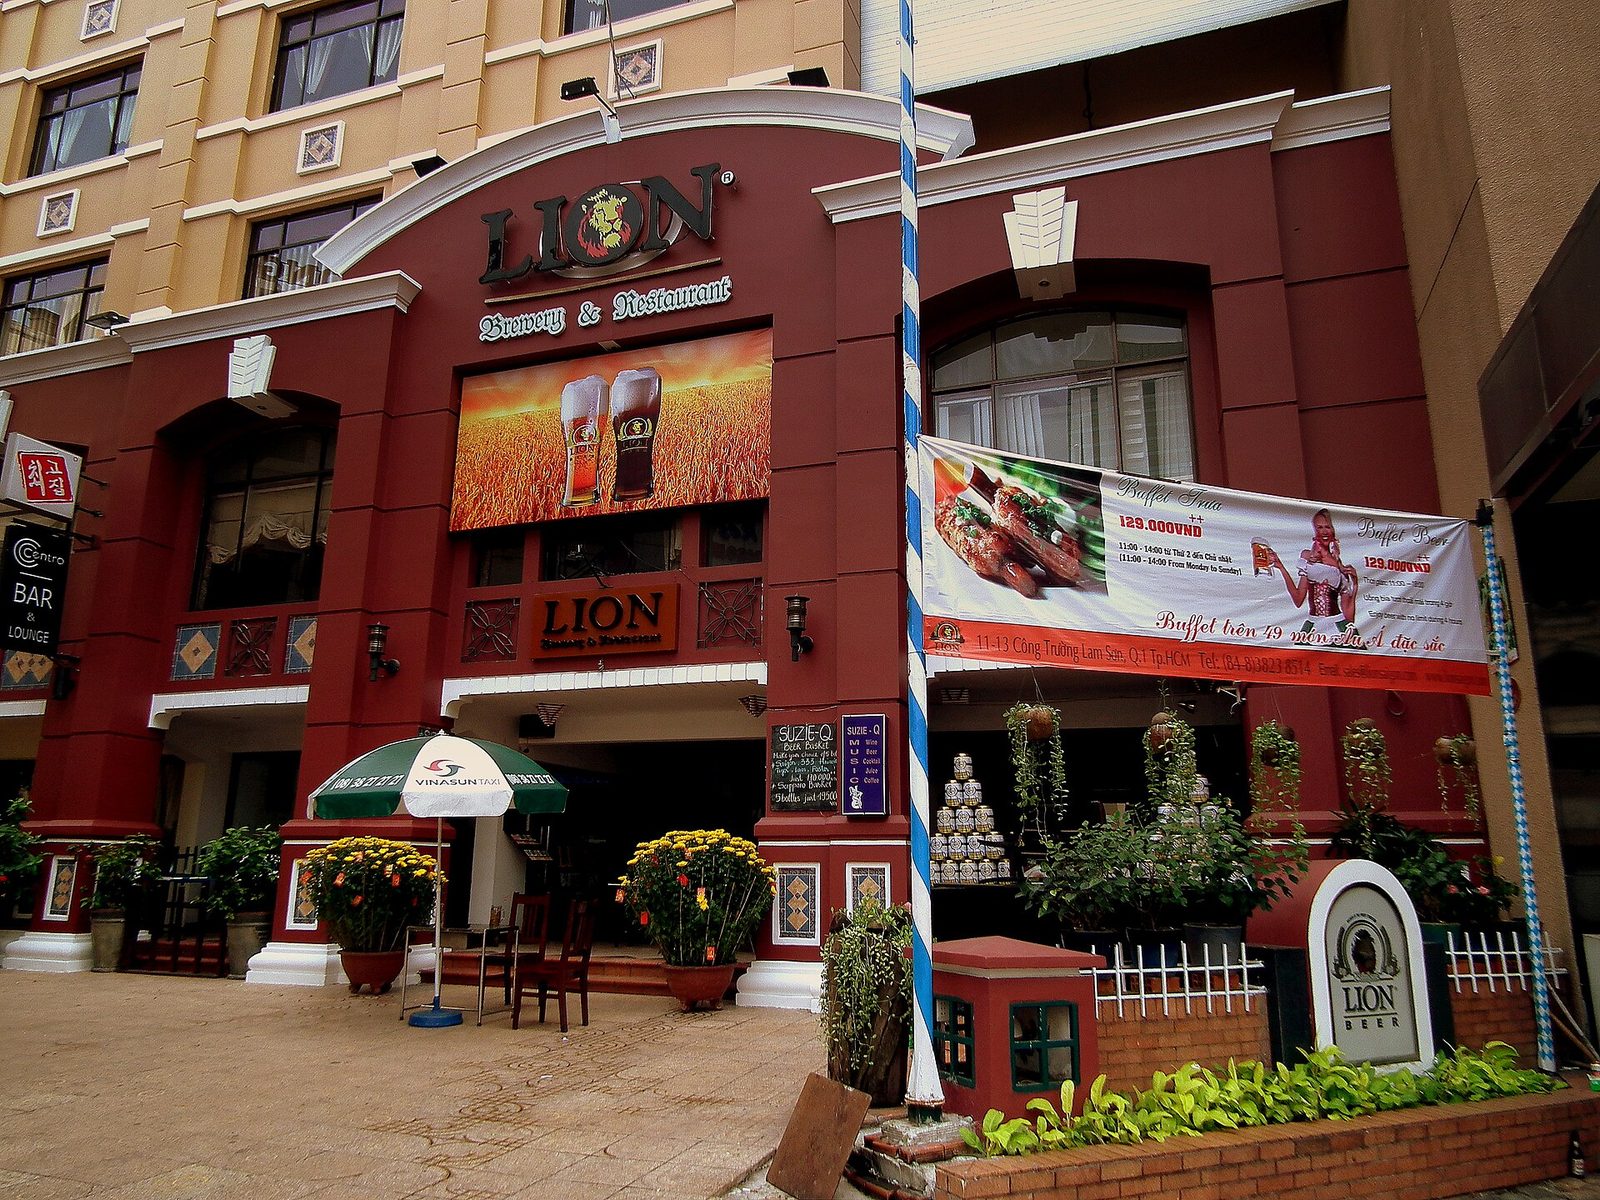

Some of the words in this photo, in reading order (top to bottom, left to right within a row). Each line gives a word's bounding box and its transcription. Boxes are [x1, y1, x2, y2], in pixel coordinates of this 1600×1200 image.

[478, 163, 721, 285] LION
[479, 306, 567, 342] Brewery
[578, 300, 603, 327] &
[613, 275, 732, 320] Restaurant
[1117, 477, 1173, 507] Buffet
[1119, 515, 1202, 538] 129.000VND
[1358, 517, 1406, 547] Buffet
[1119, 542, 1138, 552] 11:00
[1144, 545, 1163, 555] 14:00
[1147, 557, 1166, 566] 14:00
[1168, 560, 1184, 568] From
[1186, 562, 1209, 572] Monday
[1364, 556, 1431, 573] 129.000VND
[13, 582, 53, 609] BAR
[26, 612, 35, 622] &
[542, 592, 664, 635] LION
[1156, 610, 1217, 641] Buffet
[1222, 618, 1257, 638] trên
[1263, 625, 1283, 639] 49
[1290, 629, 1328, 644] món
[8, 625, 50, 644] LOUNGE
[977, 635, 1009, 651] 11-13
[1013, 637, 1041, 660] Công
[1043, 640, 1079, 663] Trường
[1081, 644, 1103, 660] Lam
[1129, 647, 1147, 665] Q.1
[1150, 649, 1191, 669] Tp.HCM
[1198, 652, 1220, 669] Tel:
[847, 726, 867, 735] SUZIE
[873, 724, 880, 735] Q
[1342, 984, 1395, 1012] LION
[1344, 1017, 1400, 1031] BEER
